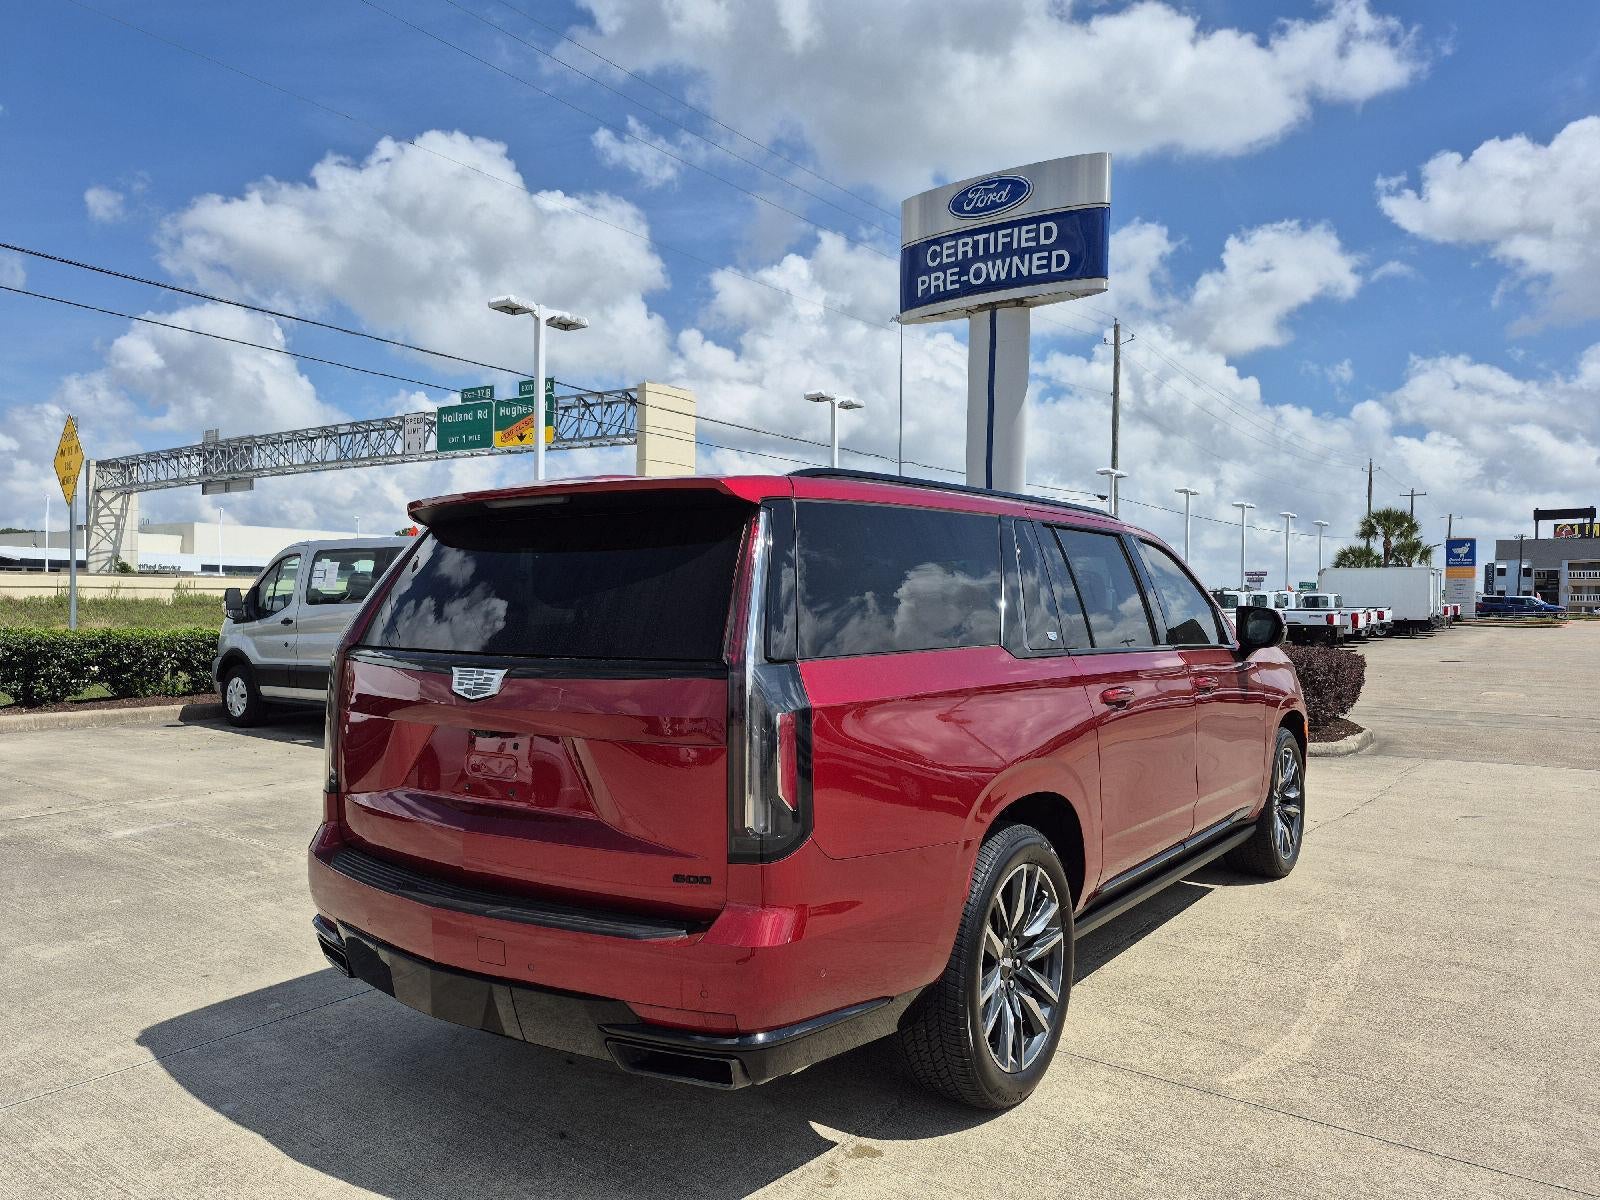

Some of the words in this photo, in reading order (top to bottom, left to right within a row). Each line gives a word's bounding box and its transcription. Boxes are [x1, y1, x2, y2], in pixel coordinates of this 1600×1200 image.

[963, 182, 1011, 211] Ford
[926, 221, 1058, 267] CERTIFIED
[917, 249, 1071, 298] PRE-OWNED
[522, 384, 533, 392] EXIT
[442, 410, 473, 423] Holland
[477, 409, 488, 419] Rd
[500, 405, 533, 418] Hughes
[406, 417, 424, 425] SPEED
[407, 427, 422, 435] LIMIT
[468, 434, 481, 442] MILE
